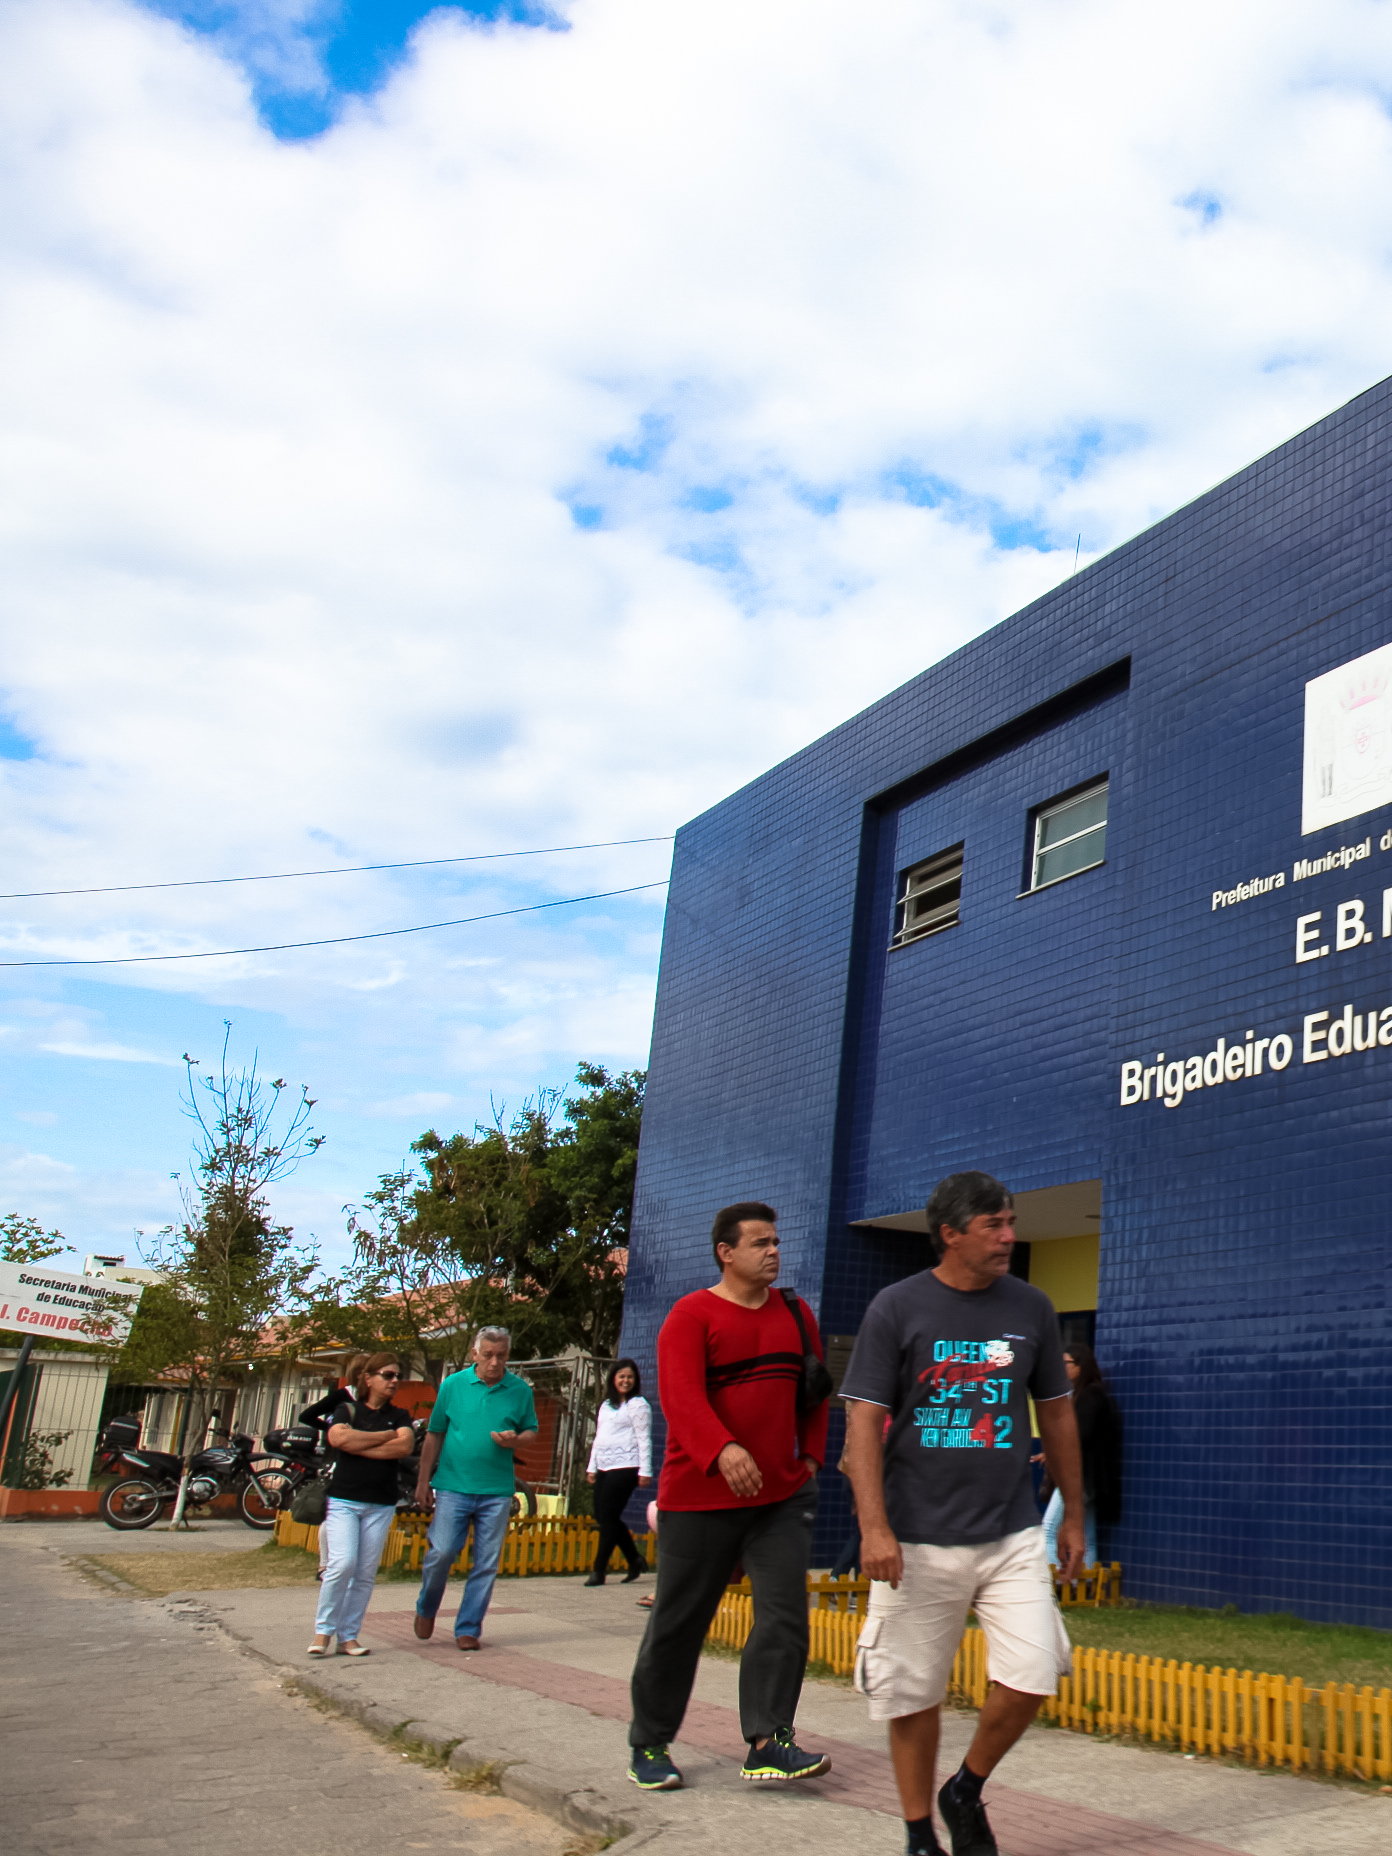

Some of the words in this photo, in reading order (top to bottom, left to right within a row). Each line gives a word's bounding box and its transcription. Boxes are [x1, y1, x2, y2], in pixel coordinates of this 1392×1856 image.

[1211, 871, 1285, 912] Prefeitura
[1292, 836, 1371, 882] Municipal
[1120, 1029, 1293, 1108] Brigadeiro
[18, 1273, 77, 1293] Secretaria
[36, 1291, 52, 1303] de
[981, 1378, 1014, 1404] ST
